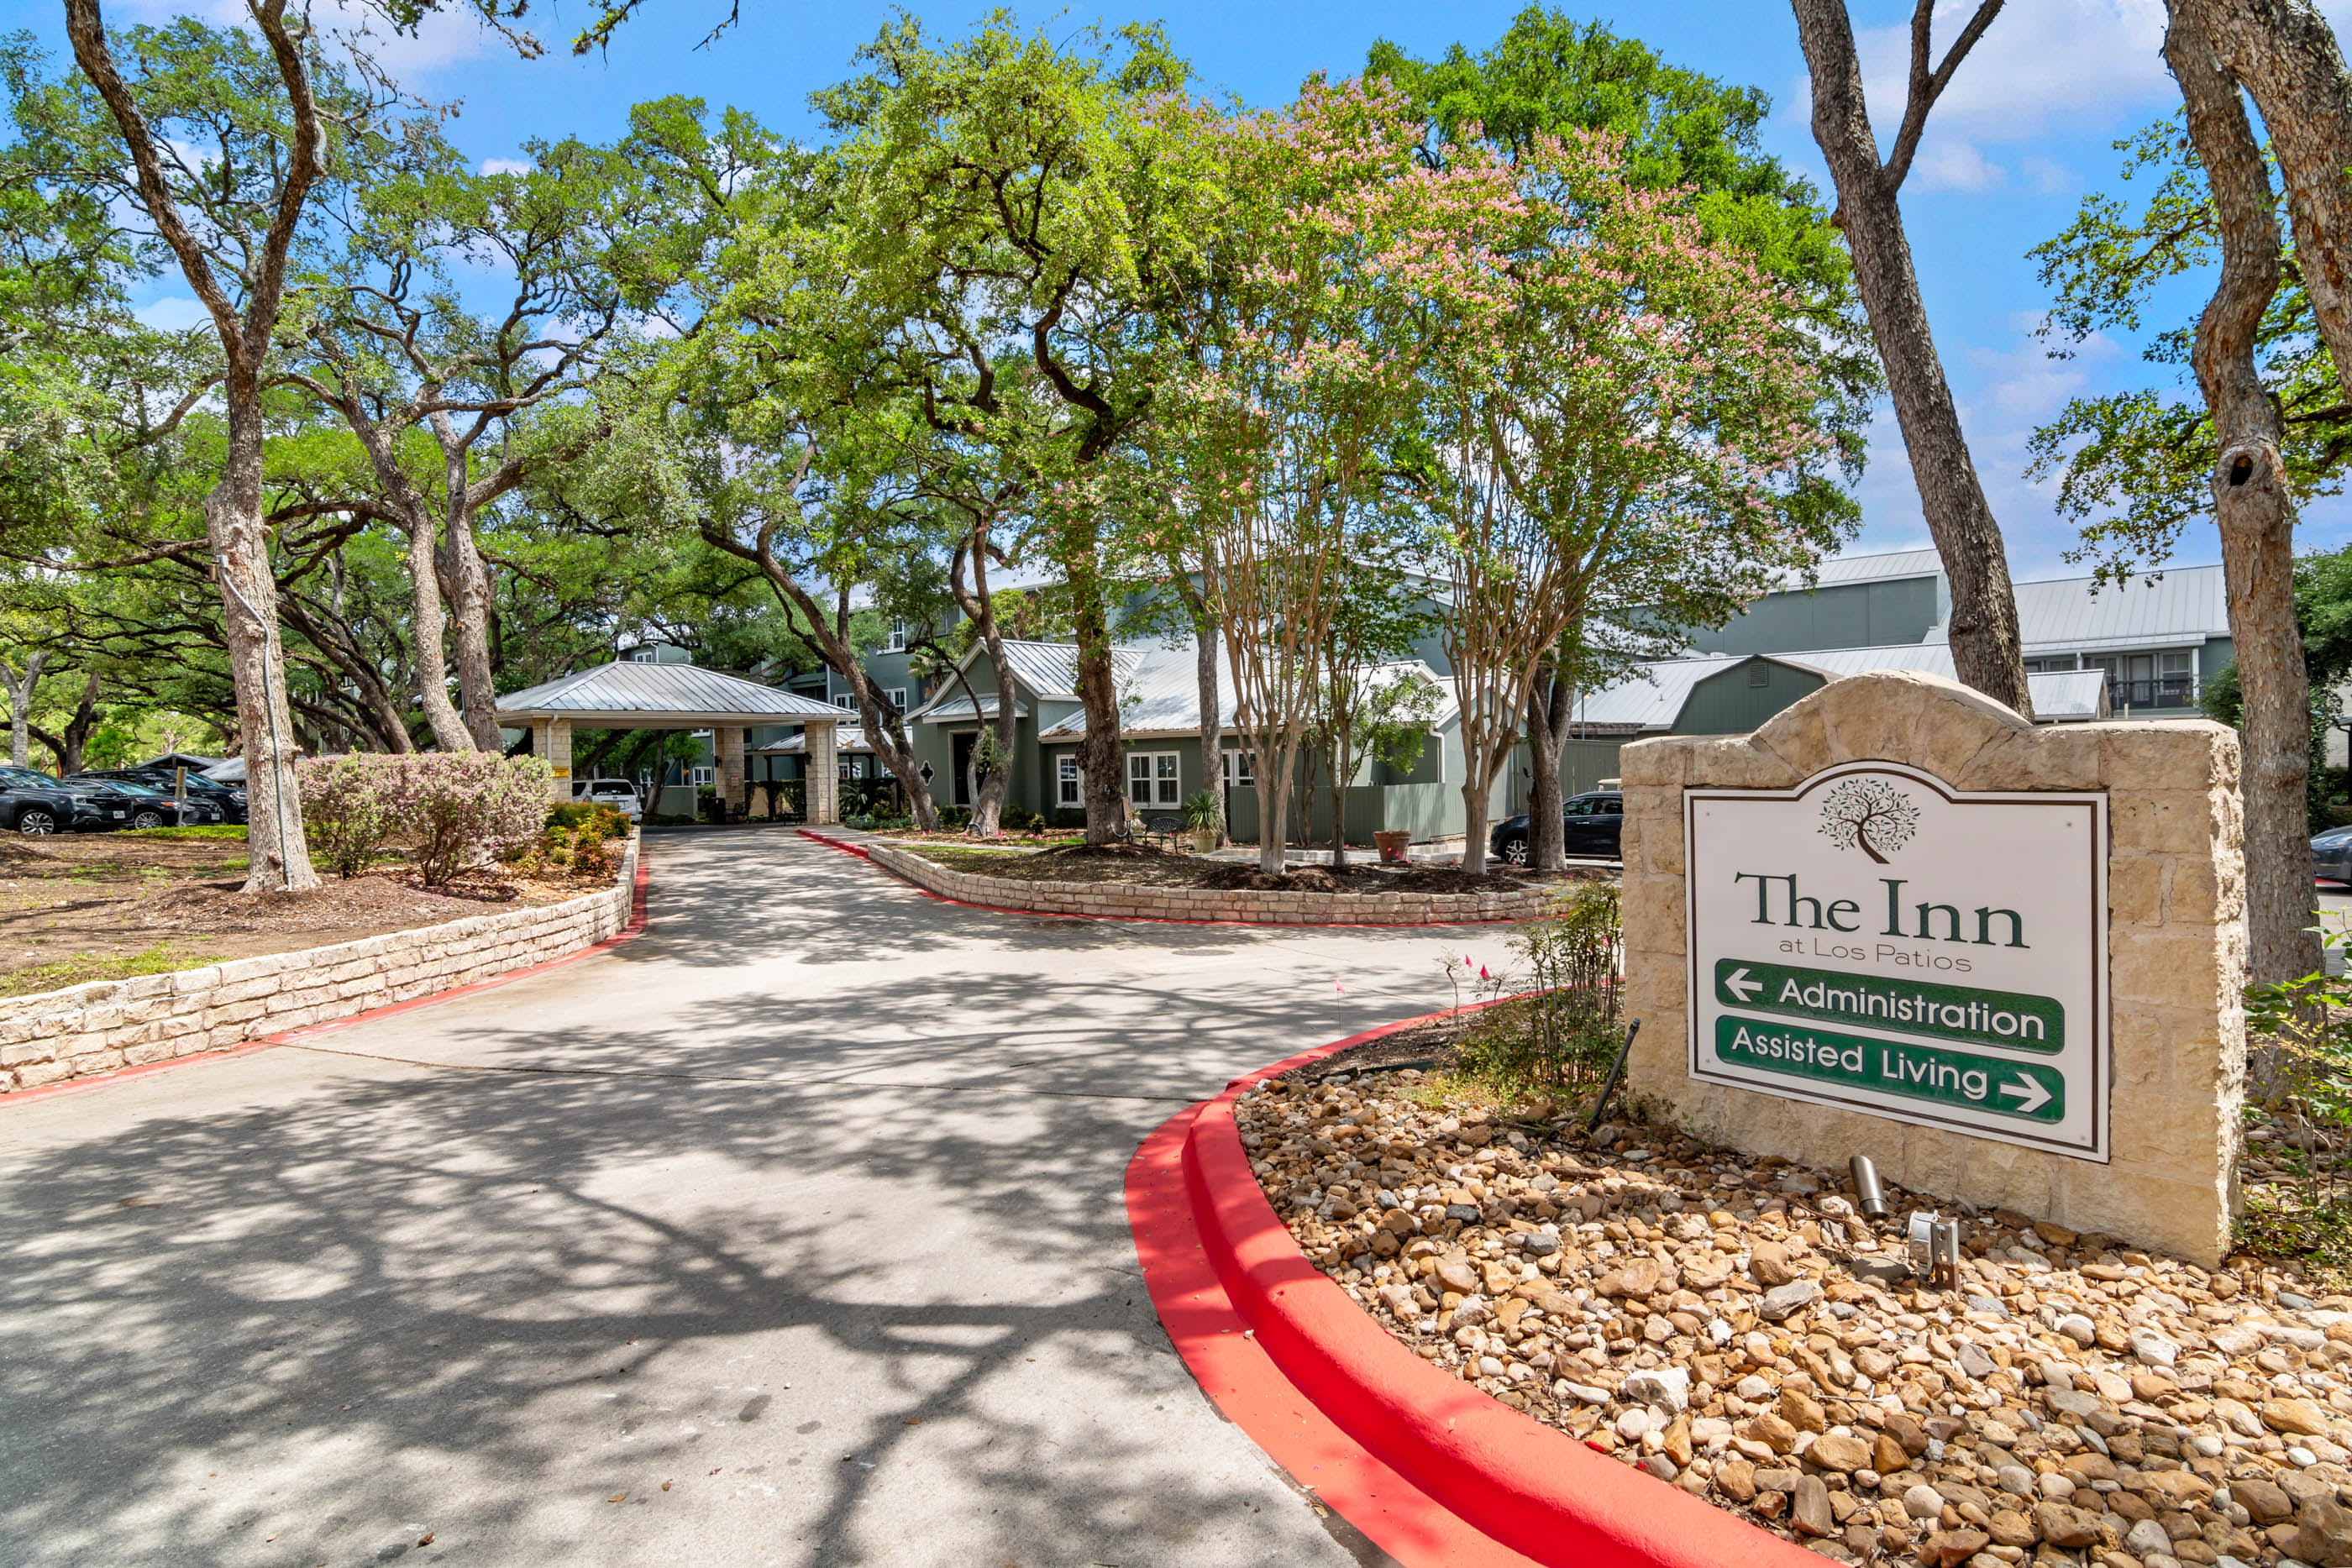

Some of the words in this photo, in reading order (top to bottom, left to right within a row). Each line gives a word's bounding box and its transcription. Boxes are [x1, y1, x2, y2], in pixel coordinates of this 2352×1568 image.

[1734, 871, 1861, 933] The
[1878, 878, 2031, 950] Inn
[1779, 938, 1805, 954] at
[1814, 937, 1866, 962] Los
[1876, 943, 1973, 973] Patios
[1778, 978, 2045, 1041] Administration
[1731, 1026, 1864, 1073] Assisted
[1882, 1048, 1989, 1100] Living
